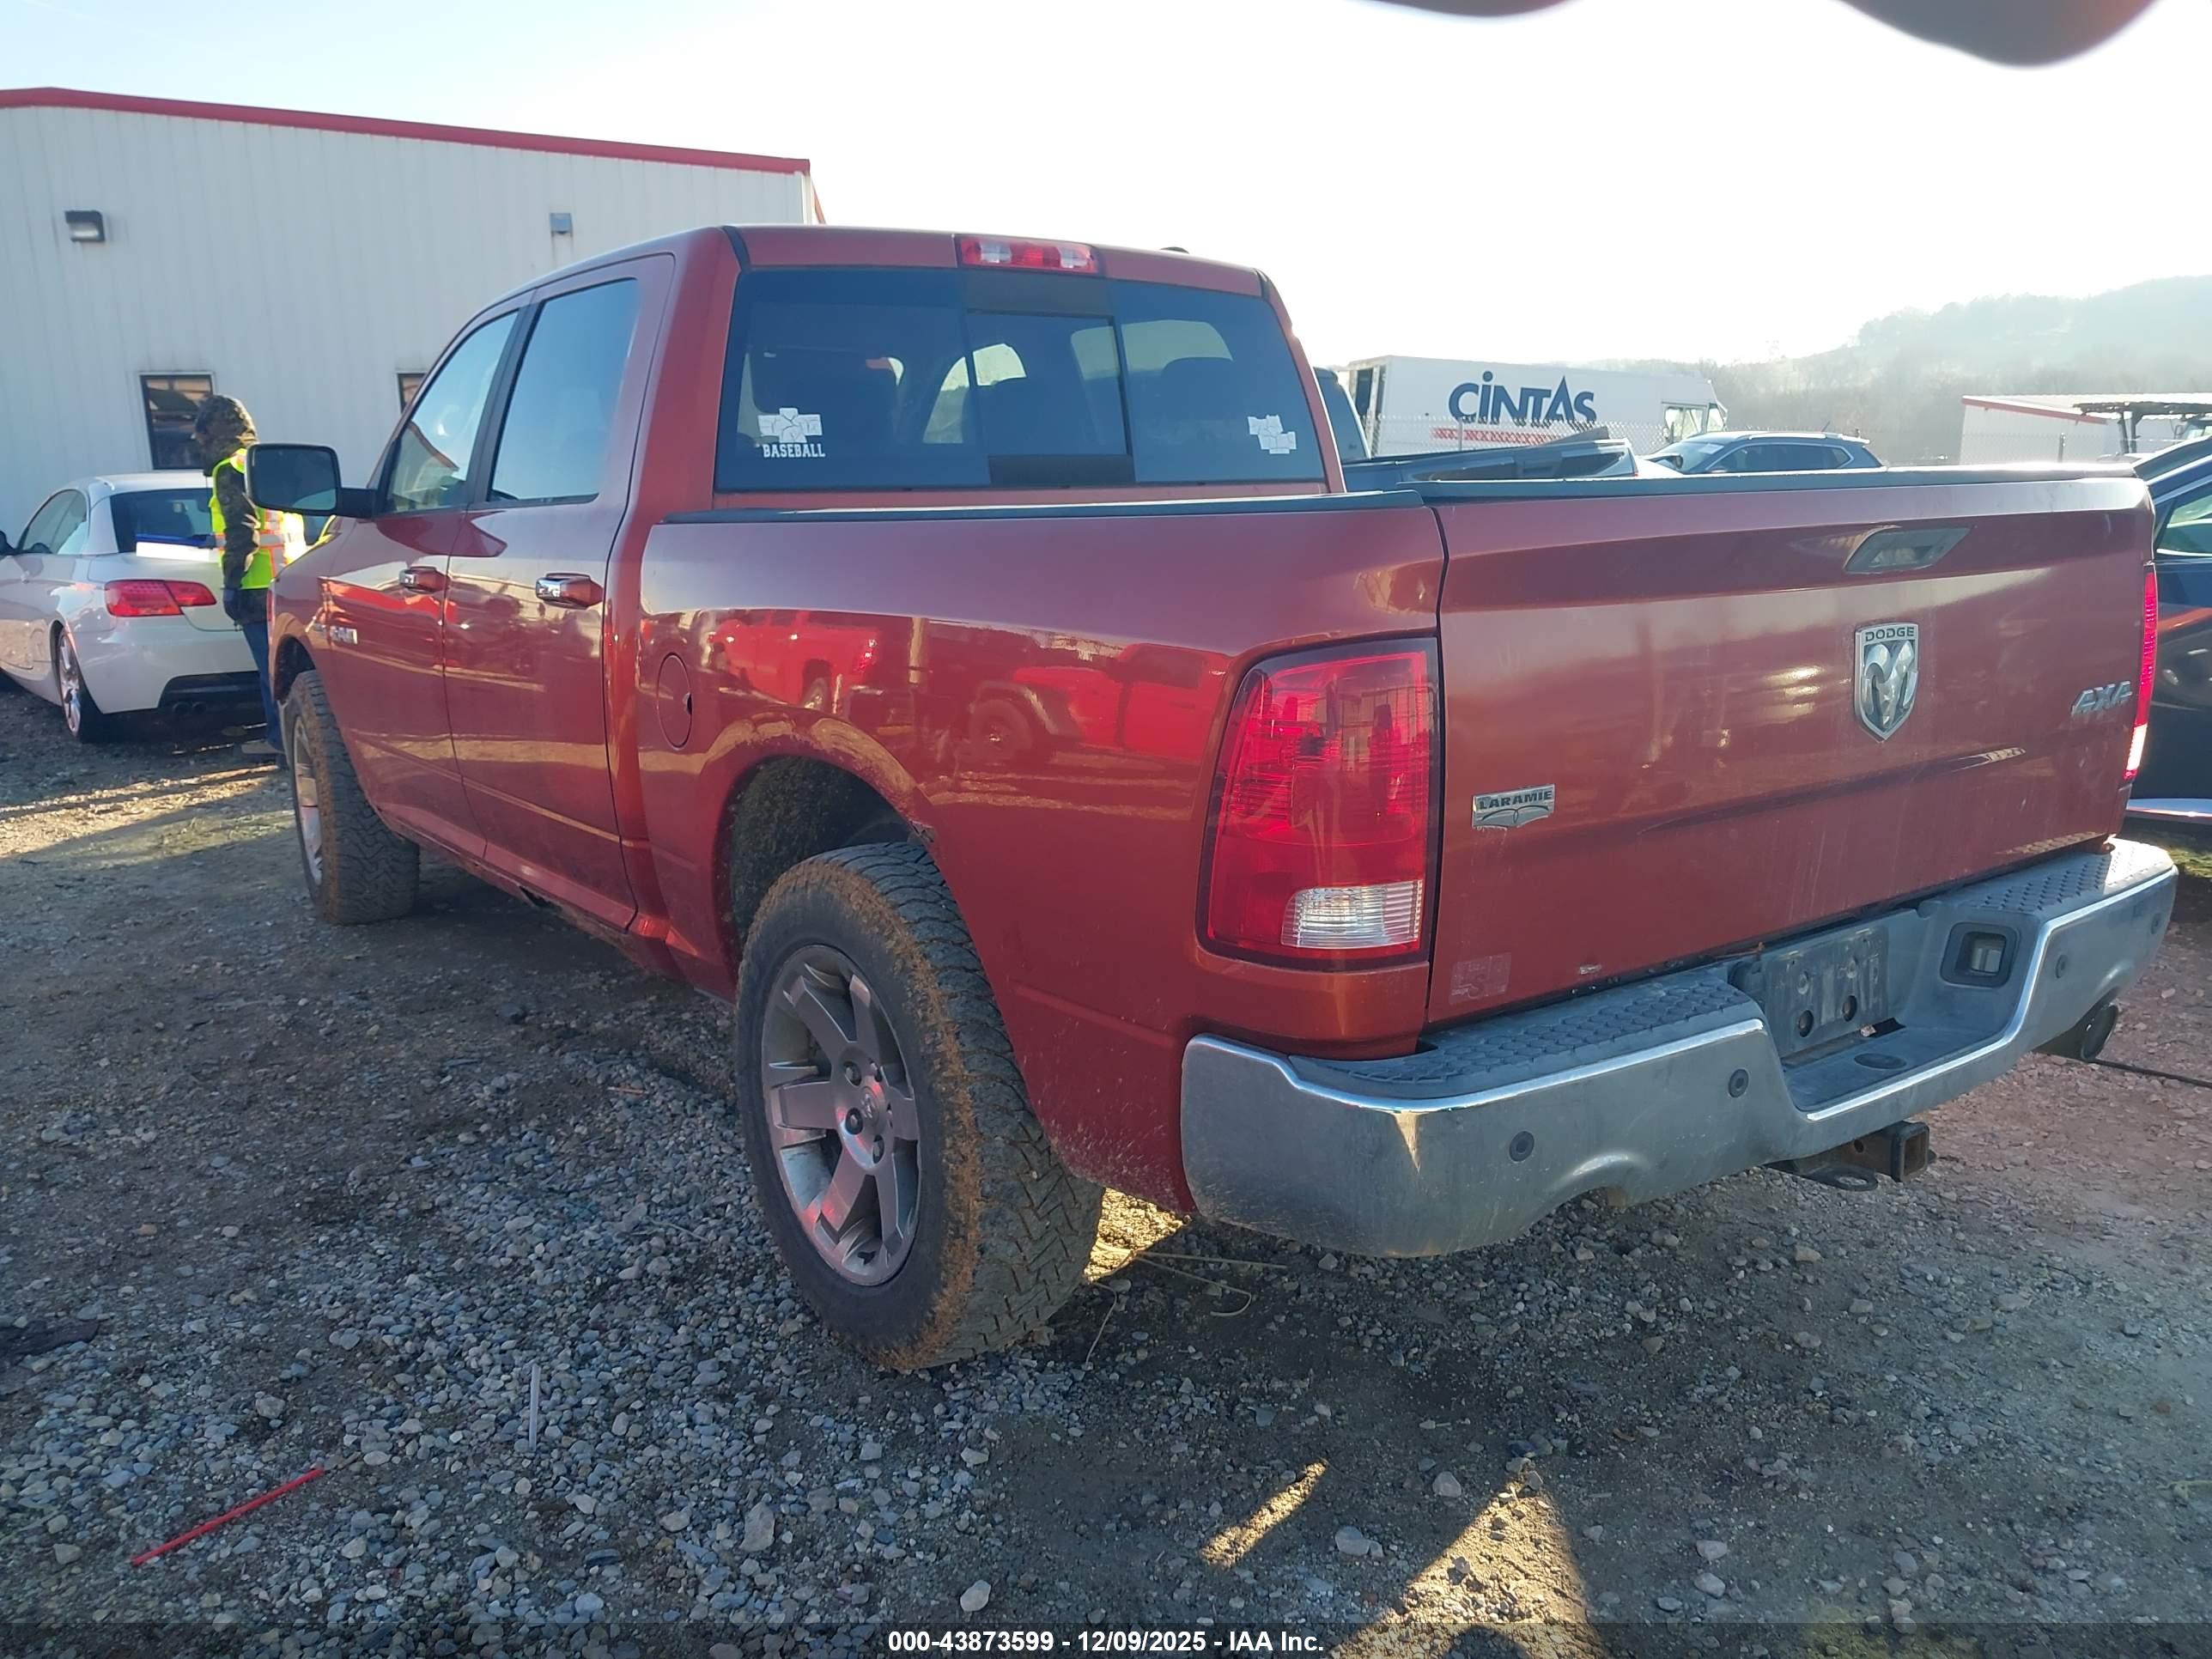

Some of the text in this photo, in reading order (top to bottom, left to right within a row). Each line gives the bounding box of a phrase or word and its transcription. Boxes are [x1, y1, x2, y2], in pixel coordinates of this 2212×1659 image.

[763, 443, 826, 458] BASEBALL
[1865, 627, 1915, 641] DODGE
[1479, 790, 1553, 810] LARAMIE
